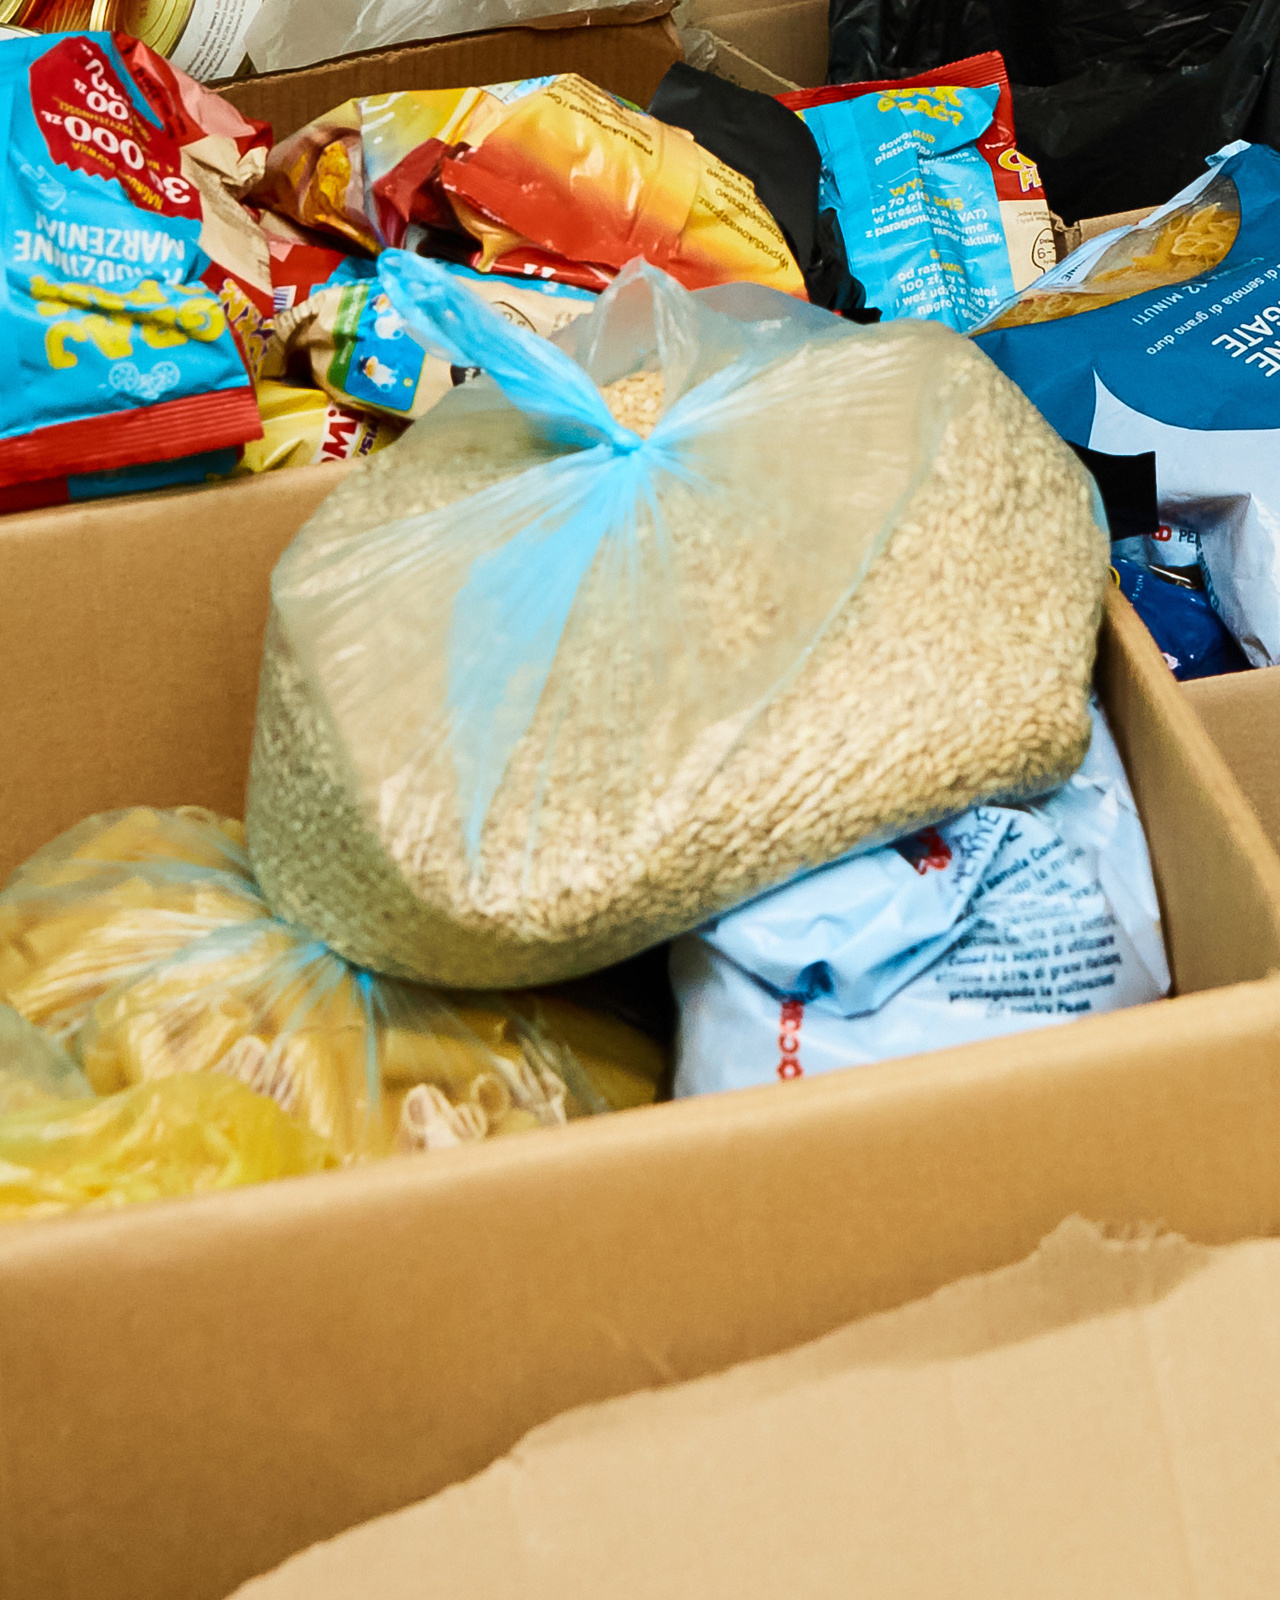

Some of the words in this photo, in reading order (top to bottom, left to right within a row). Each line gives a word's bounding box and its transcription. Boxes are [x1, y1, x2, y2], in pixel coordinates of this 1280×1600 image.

[1263, 267, 1279, 282] di
[1221, 276, 1265, 306] semola
[1131, 292, 1184, 326] MINUTI
[1208, 302, 1224, 317] di
[1174, 310, 1210, 336] grano
[1146, 333, 1176, 356] duro
